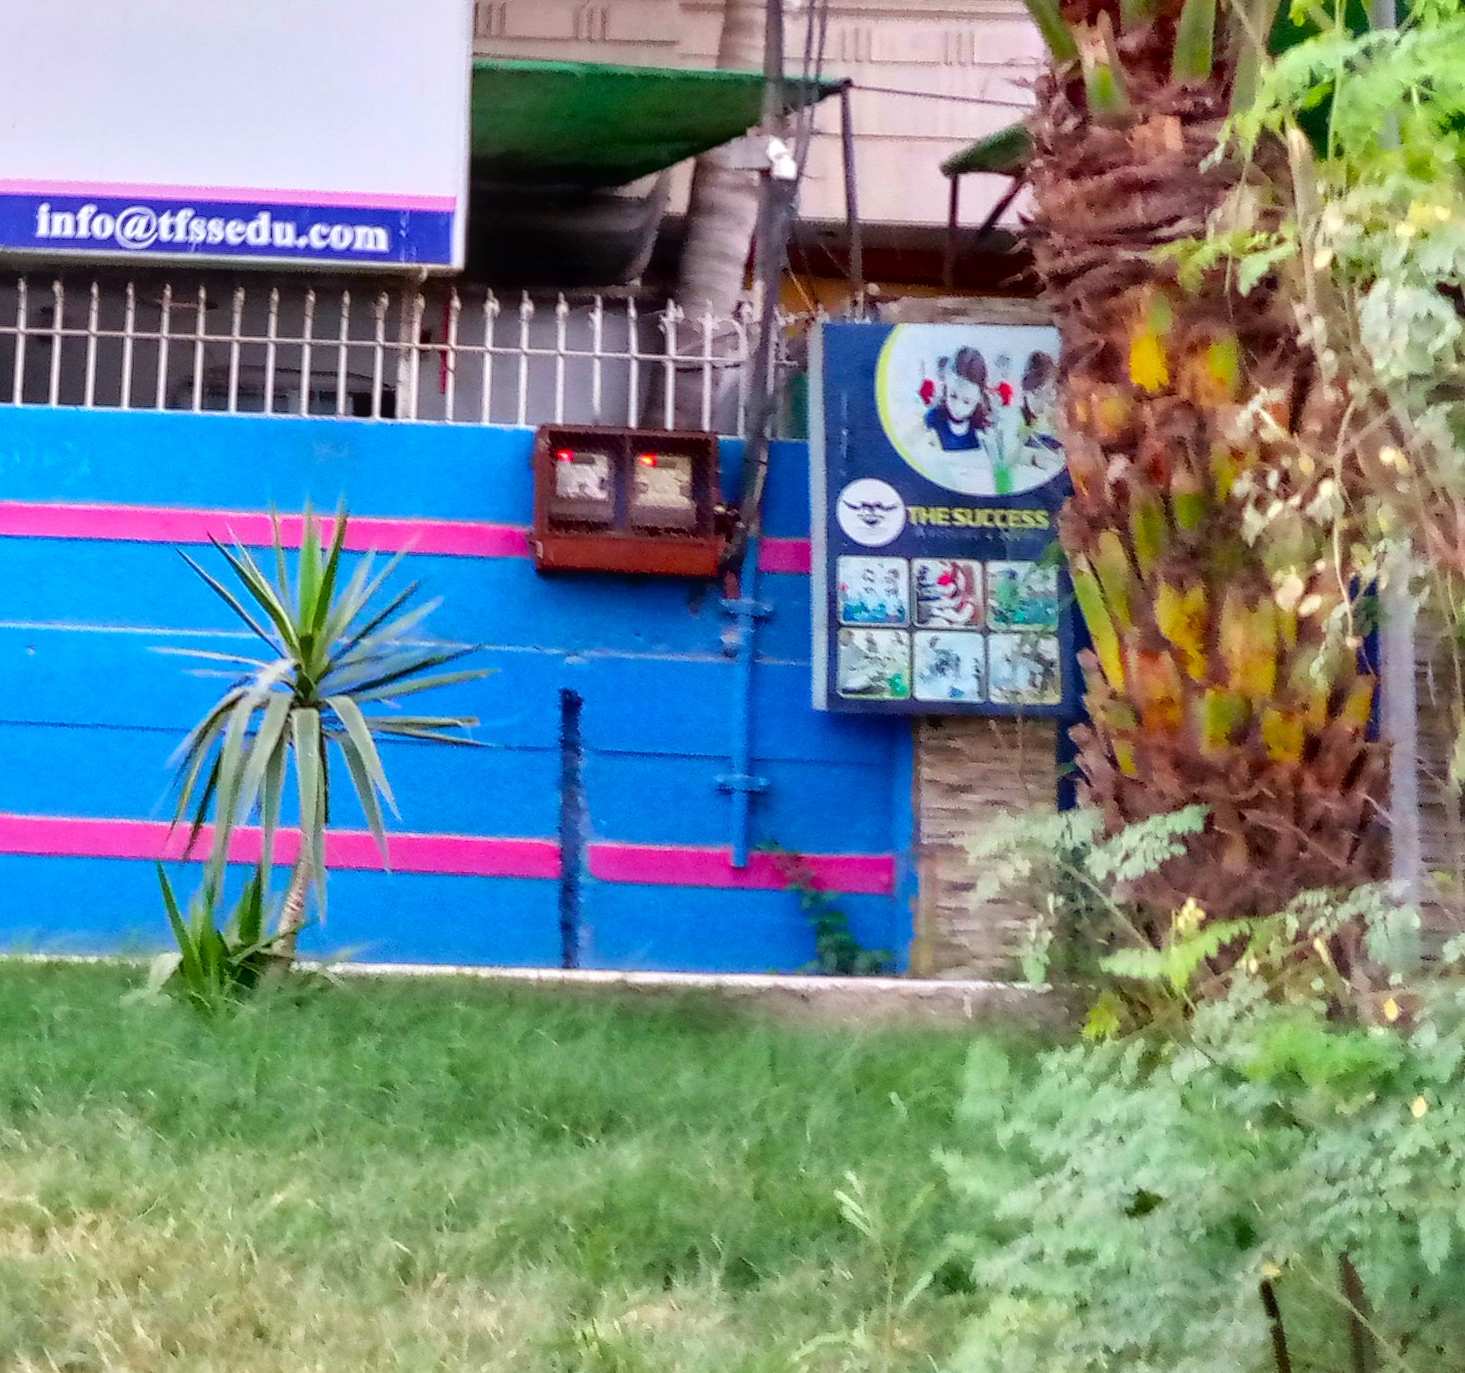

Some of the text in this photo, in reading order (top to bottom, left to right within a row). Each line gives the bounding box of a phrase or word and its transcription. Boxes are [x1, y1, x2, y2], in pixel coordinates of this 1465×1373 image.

[36, 202, 390, 254] info@tfssedu.com
[907, 505, 1052, 531] THE SUCCESS
